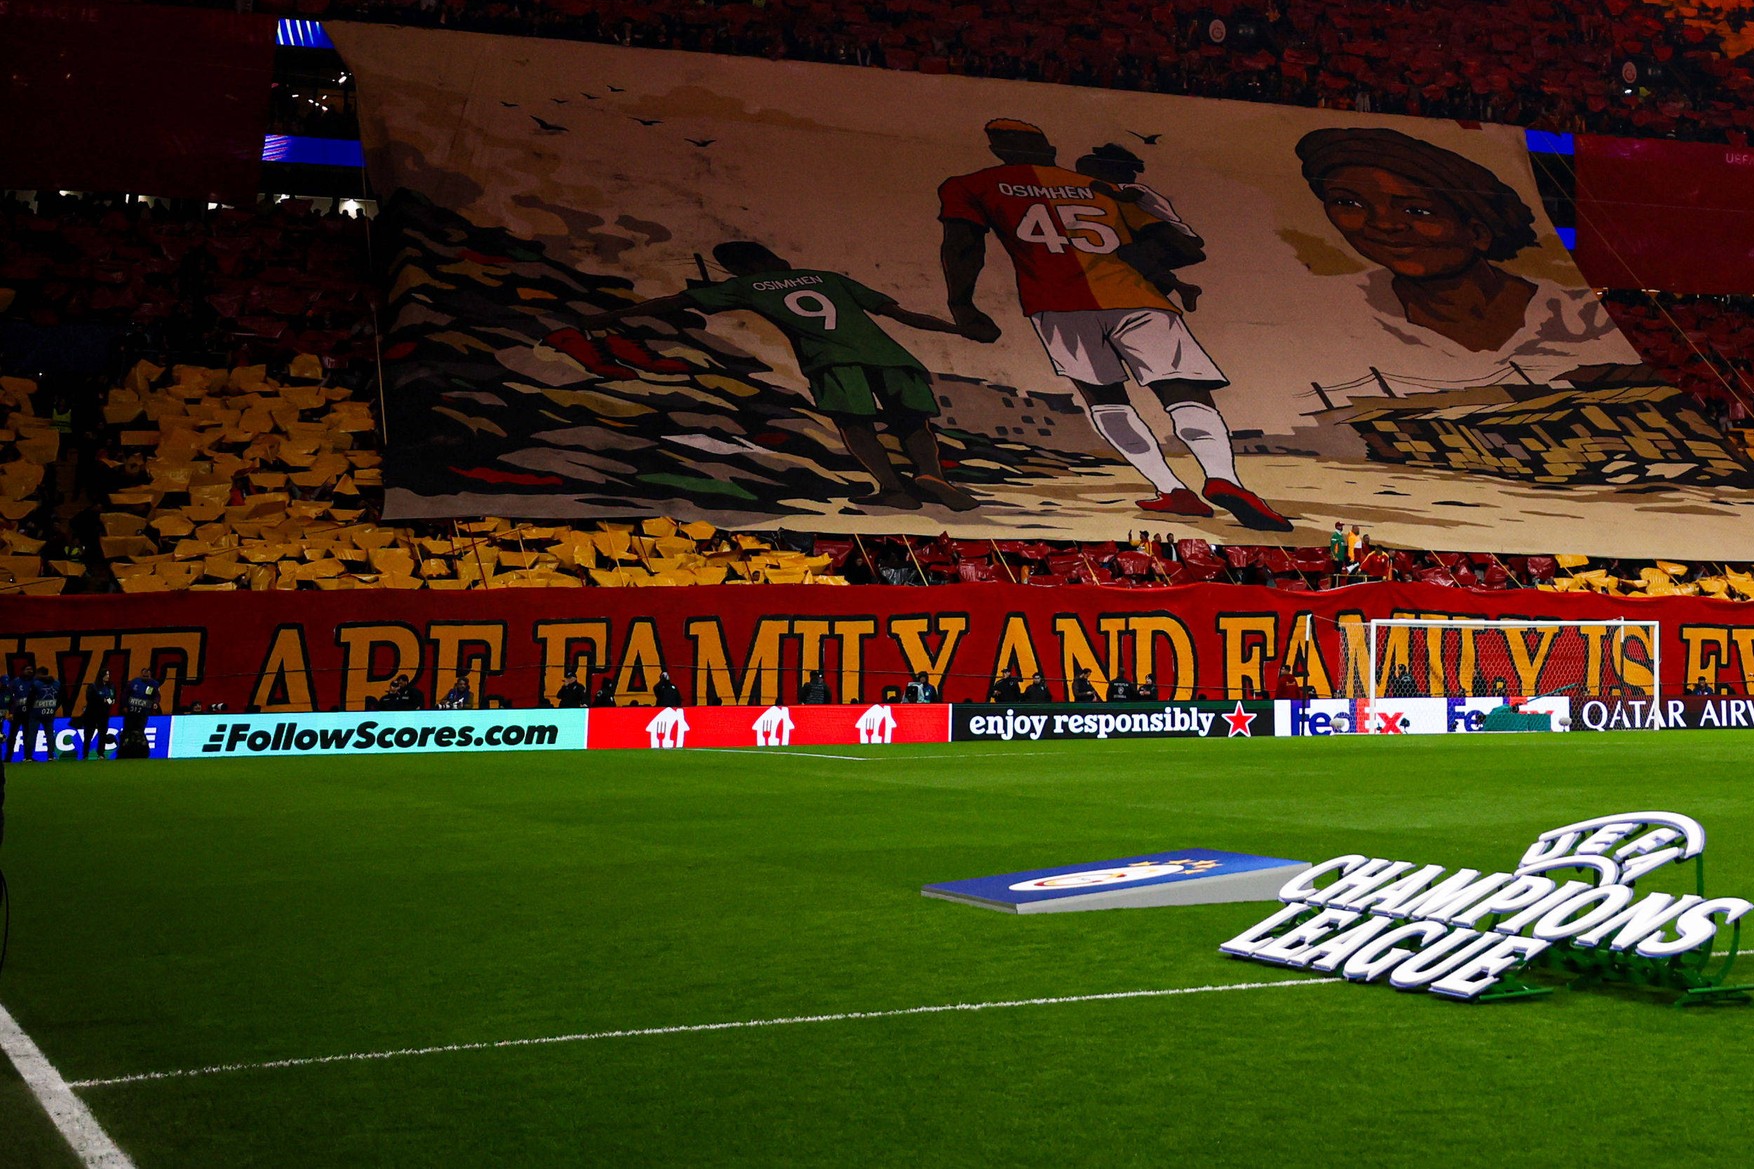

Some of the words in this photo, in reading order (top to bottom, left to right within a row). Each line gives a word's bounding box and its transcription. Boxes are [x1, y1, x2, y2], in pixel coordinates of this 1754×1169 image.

[1000, 182, 1093, 200] OSIMHEN
[1016, 203, 1120, 255] 45
[752, 274, 824, 292] OSIMHEN
[783, 289, 837, 330] 9
[252, 624, 503, 712] ARE
[535, 617, 968, 706] FAMILY
[992, 612, 1198, 702] AND
[970, 710, 1047, 740] enjoy
[1054, 707, 1215, 737] responsibly
[1291, 699, 1405, 735] FedEx
[1583, 702, 1684, 731] QATAR
[1521, 820, 1684, 887] UEFA
[1278, 854, 1754, 959] CHAMPIONS
[1218, 902, 1552, 1001] LEAGUE
